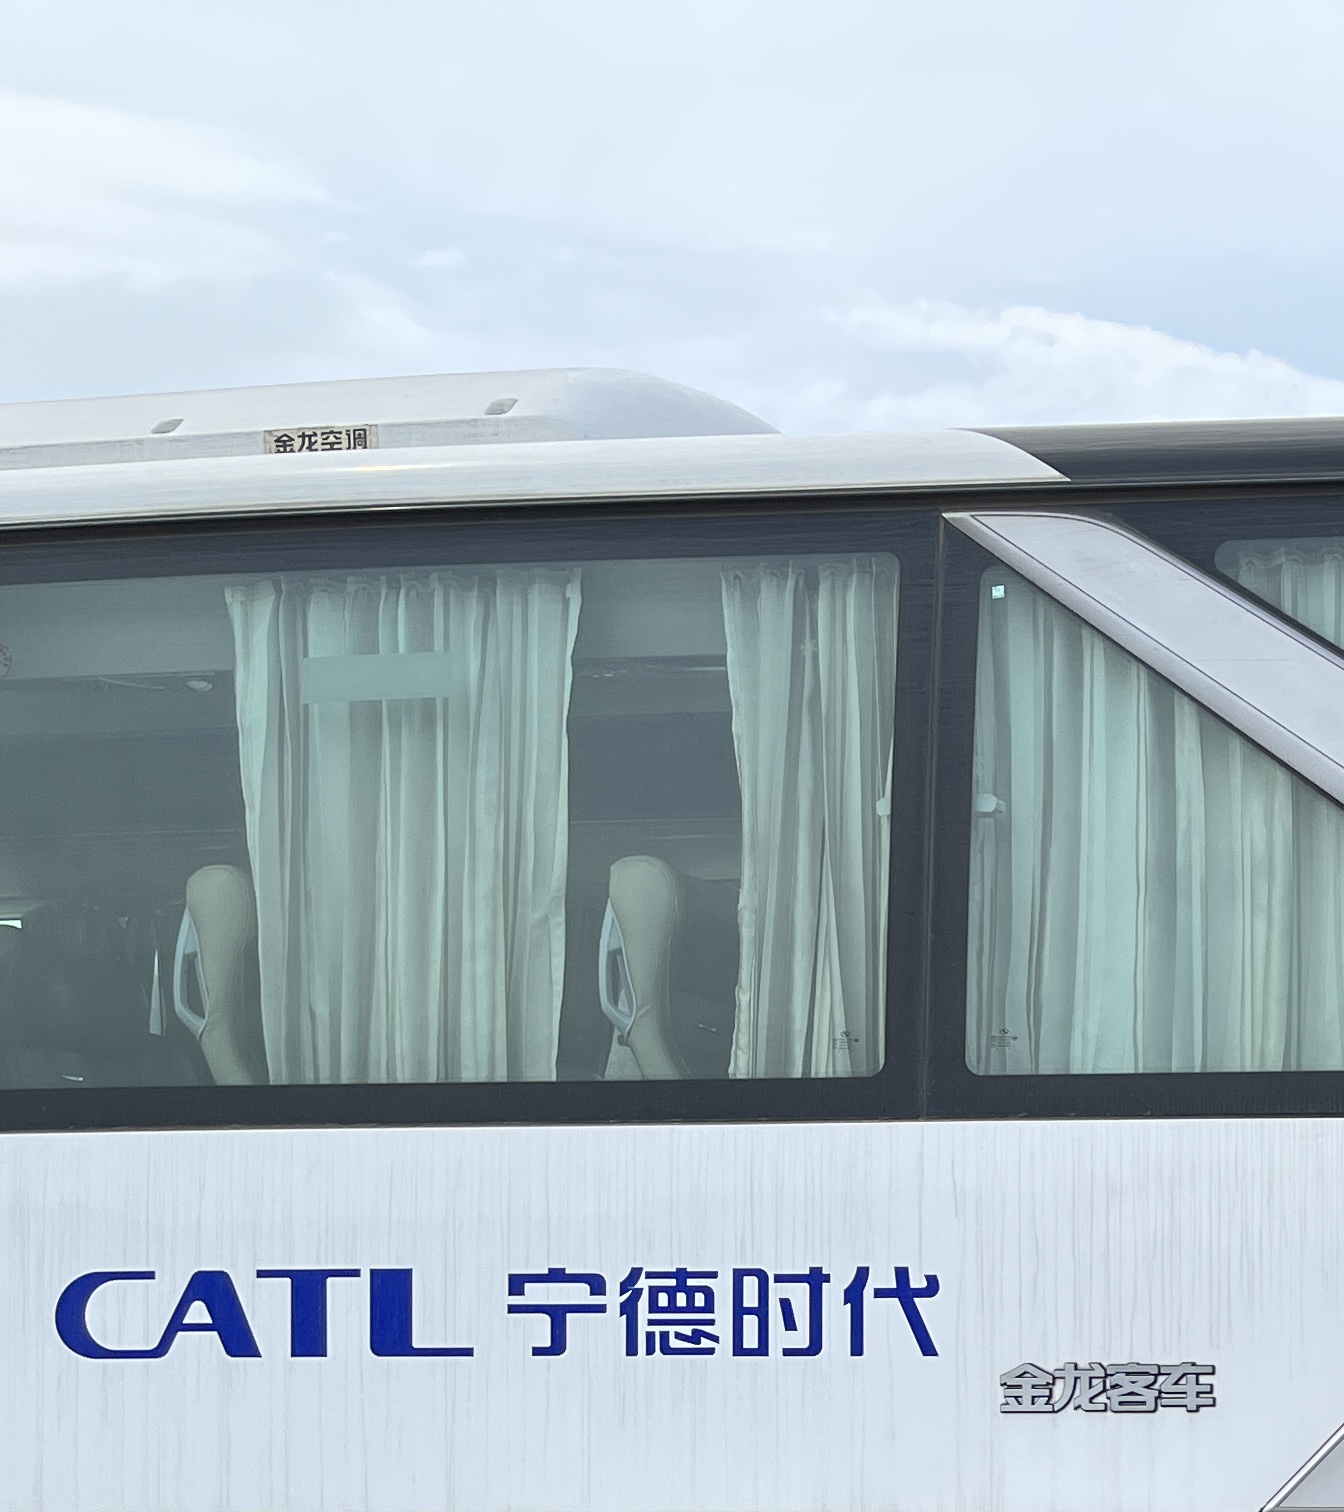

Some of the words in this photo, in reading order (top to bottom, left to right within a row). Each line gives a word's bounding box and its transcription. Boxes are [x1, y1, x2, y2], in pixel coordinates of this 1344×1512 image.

[273, 428, 368, 454] 金龙空调
[55, 1268, 474, 1359] CATL
[507, 1266, 940, 1358] 宁德时代
[999, 1361, 1216, 1414] 金龙客车
